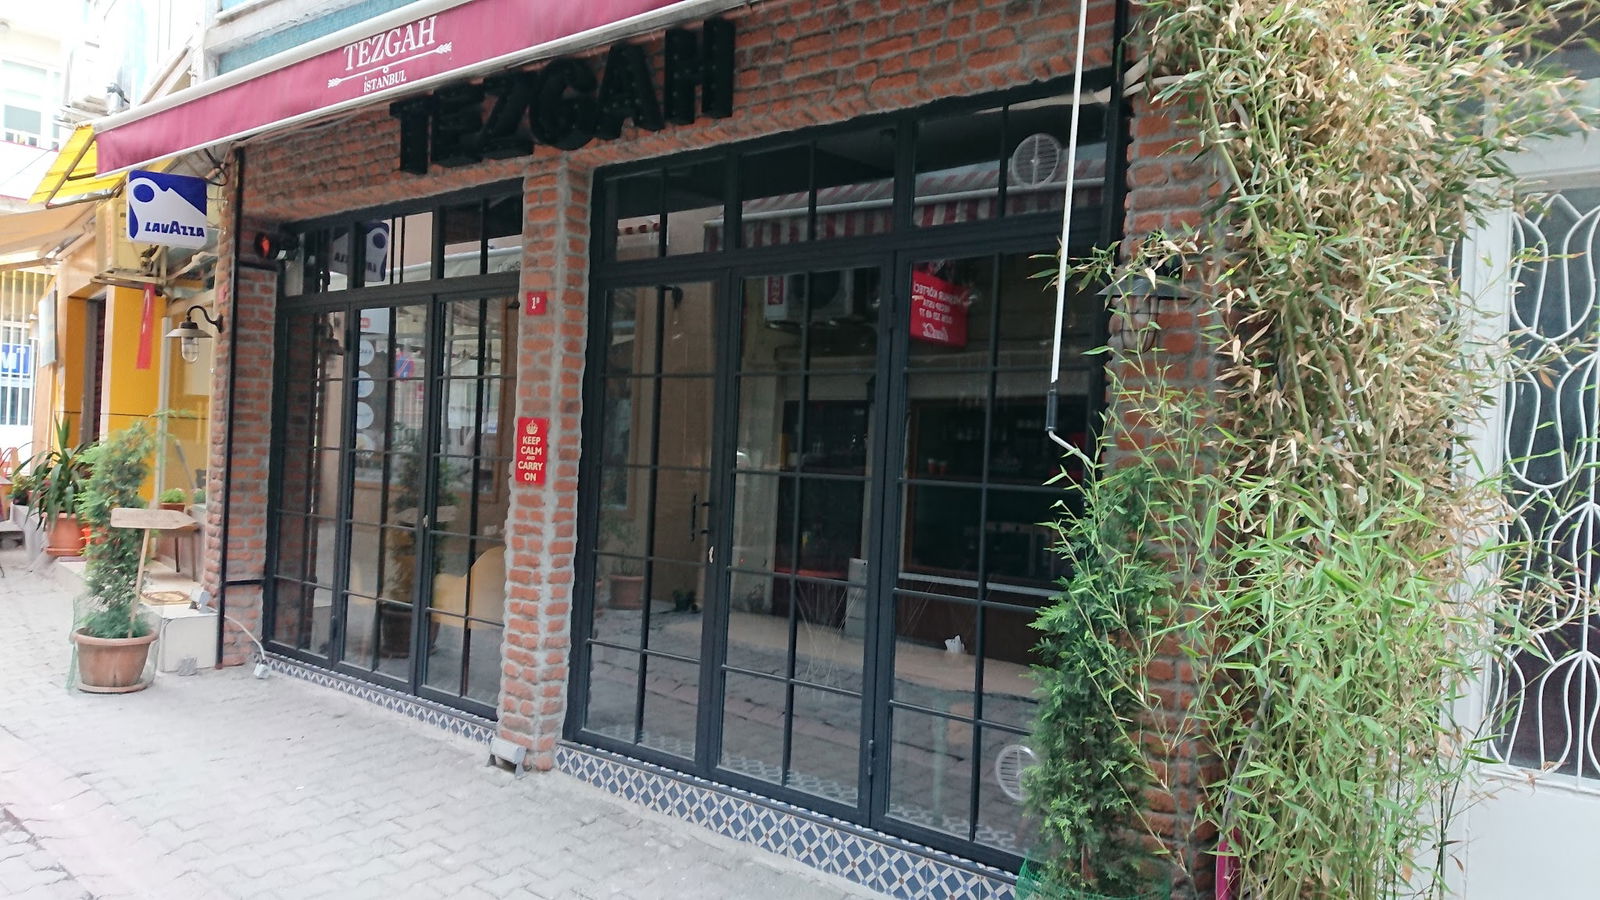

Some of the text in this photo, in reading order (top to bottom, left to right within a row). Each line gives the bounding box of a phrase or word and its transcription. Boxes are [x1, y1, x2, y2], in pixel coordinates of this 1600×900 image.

[343, 15, 437, 71] TEZGAH
[363, 69, 407, 93] İSTANBUL
[390, 16, 737, 175] TEZGAH
[144, 220, 205, 238] LAVAZZA
[522, 435, 541, 445] KEEP
[520, 446, 542, 456] CALM
[517, 460, 544, 471] CARRY
[523, 472, 537, 482] ON
